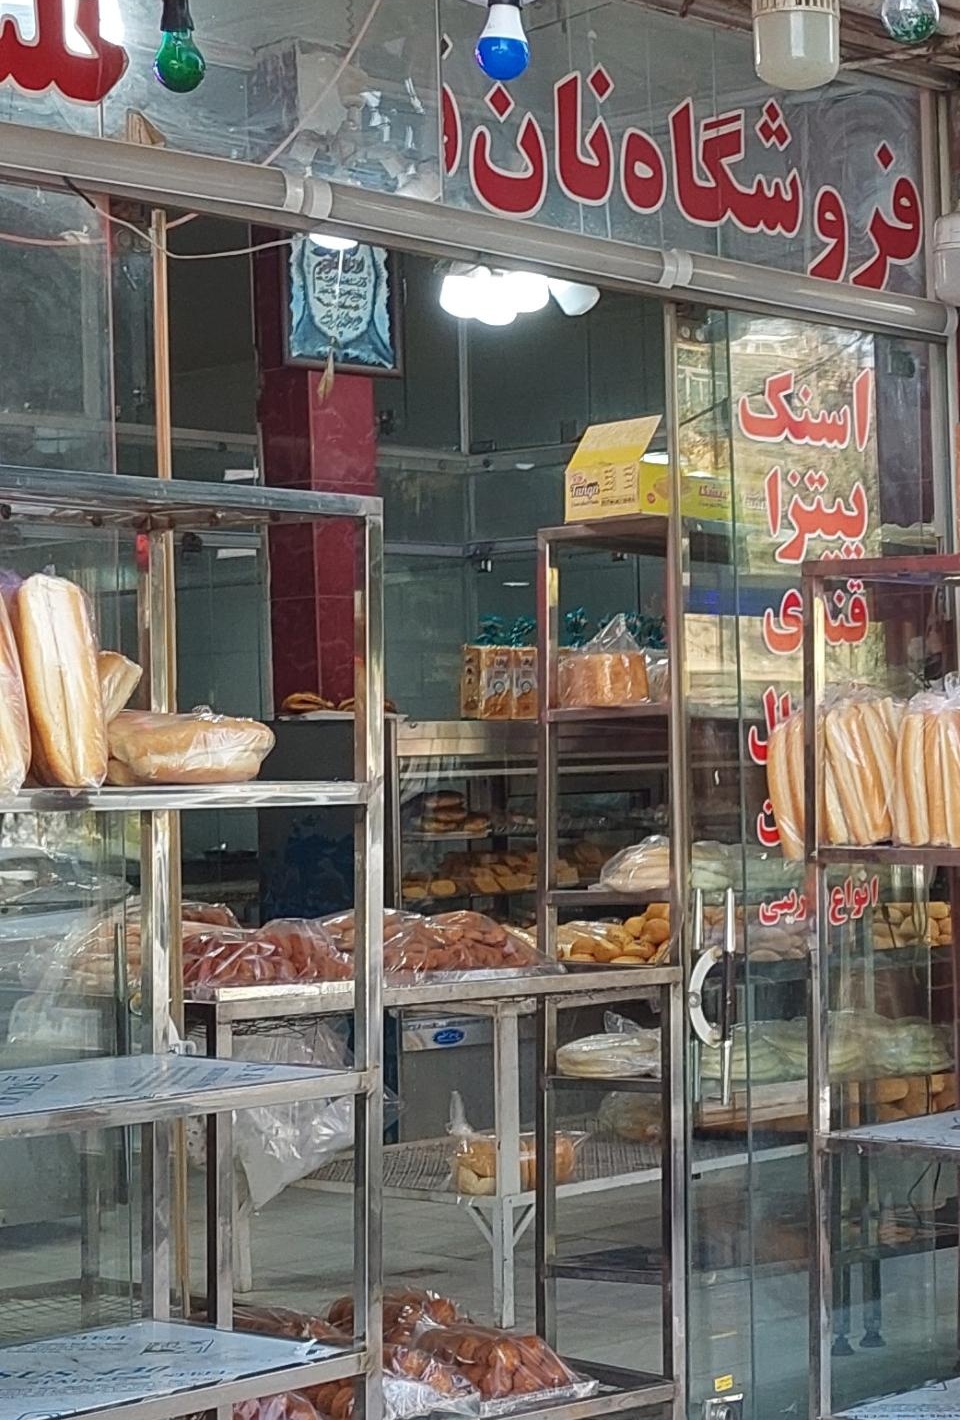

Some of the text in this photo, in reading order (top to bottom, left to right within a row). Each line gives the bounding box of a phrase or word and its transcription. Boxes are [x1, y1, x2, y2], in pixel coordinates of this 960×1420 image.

[469, 60, 616, 221] نان
[620, 95, 925, 291] فروشگاه
[738, 367, 872, 453] اسنک
[765, 465, 868, 564] پیتزا
[763, 578, 869, 655] قنی
